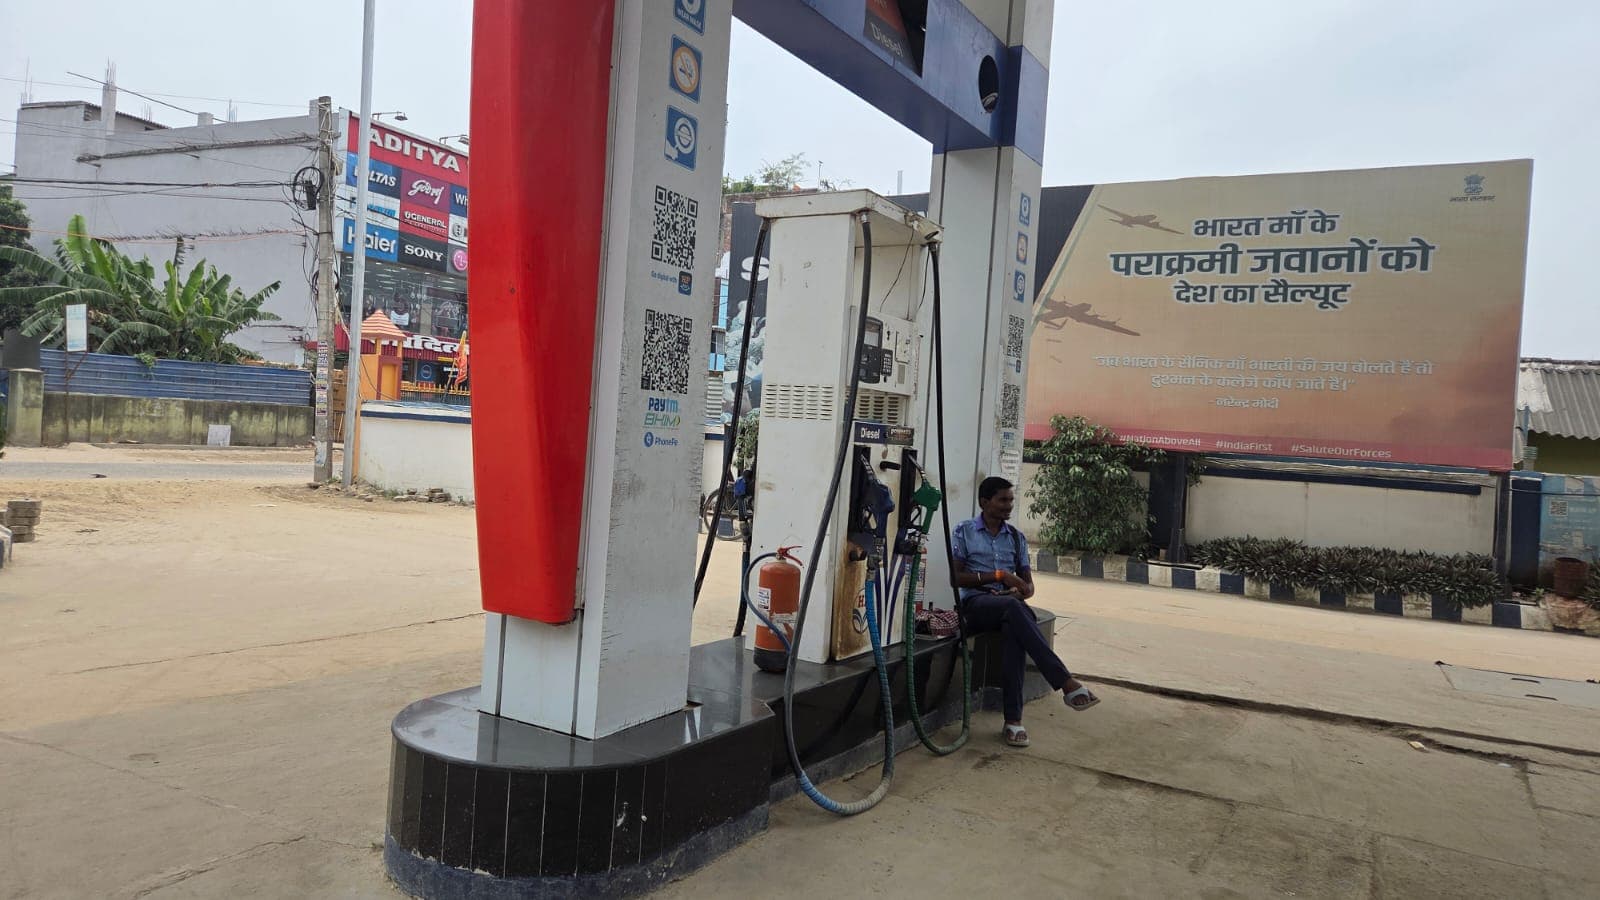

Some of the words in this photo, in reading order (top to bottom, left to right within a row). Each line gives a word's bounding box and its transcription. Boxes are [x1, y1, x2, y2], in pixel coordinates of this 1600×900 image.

[870, 22, 904, 57] Diesel
[369, 128, 460, 173] ADITYA
[1194, 217, 1264, 237] भारत
[1308, 209, 1340, 234] के
[404, 244, 443, 262] SONY
[1110, 242, 1243, 277] पराक्रमी
[1246, 237, 1378, 274] जवानों
[1378, 237, 1436, 272] को
[1174, 279, 1219, 303] देश
[1221, 284, 1260, 303] का
[1261, 278, 1352, 309] सैल्यूट
[1122, 355, 1158, 369] भारत
[1160, 354, 1176, 369] के
[1178, 355, 1224, 370] सैनिक
[1249, 357, 1293, 372] भारती
[1295, 356, 1317, 373] की
[1319, 360, 1348, 373] जय
[1351, 357, 1397, 375] बोलते
[1416, 359, 1435, 376] तो
[1151, 373, 1196, 388] दुश्मन
[1199, 372, 1213, 386] के
[1215, 374, 1260, 389] कलेजे
[1295, 376, 1325, 391] जाते
[1251, 396, 1279, 409] मोदी
[644, 412, 677, 427] BHIM
[860, 427, 881, 440] Diesel
[1215, 440, 1273, 452] #IndiaFirst
[1291, 443, 1392, 458] #SaluteOurForces
